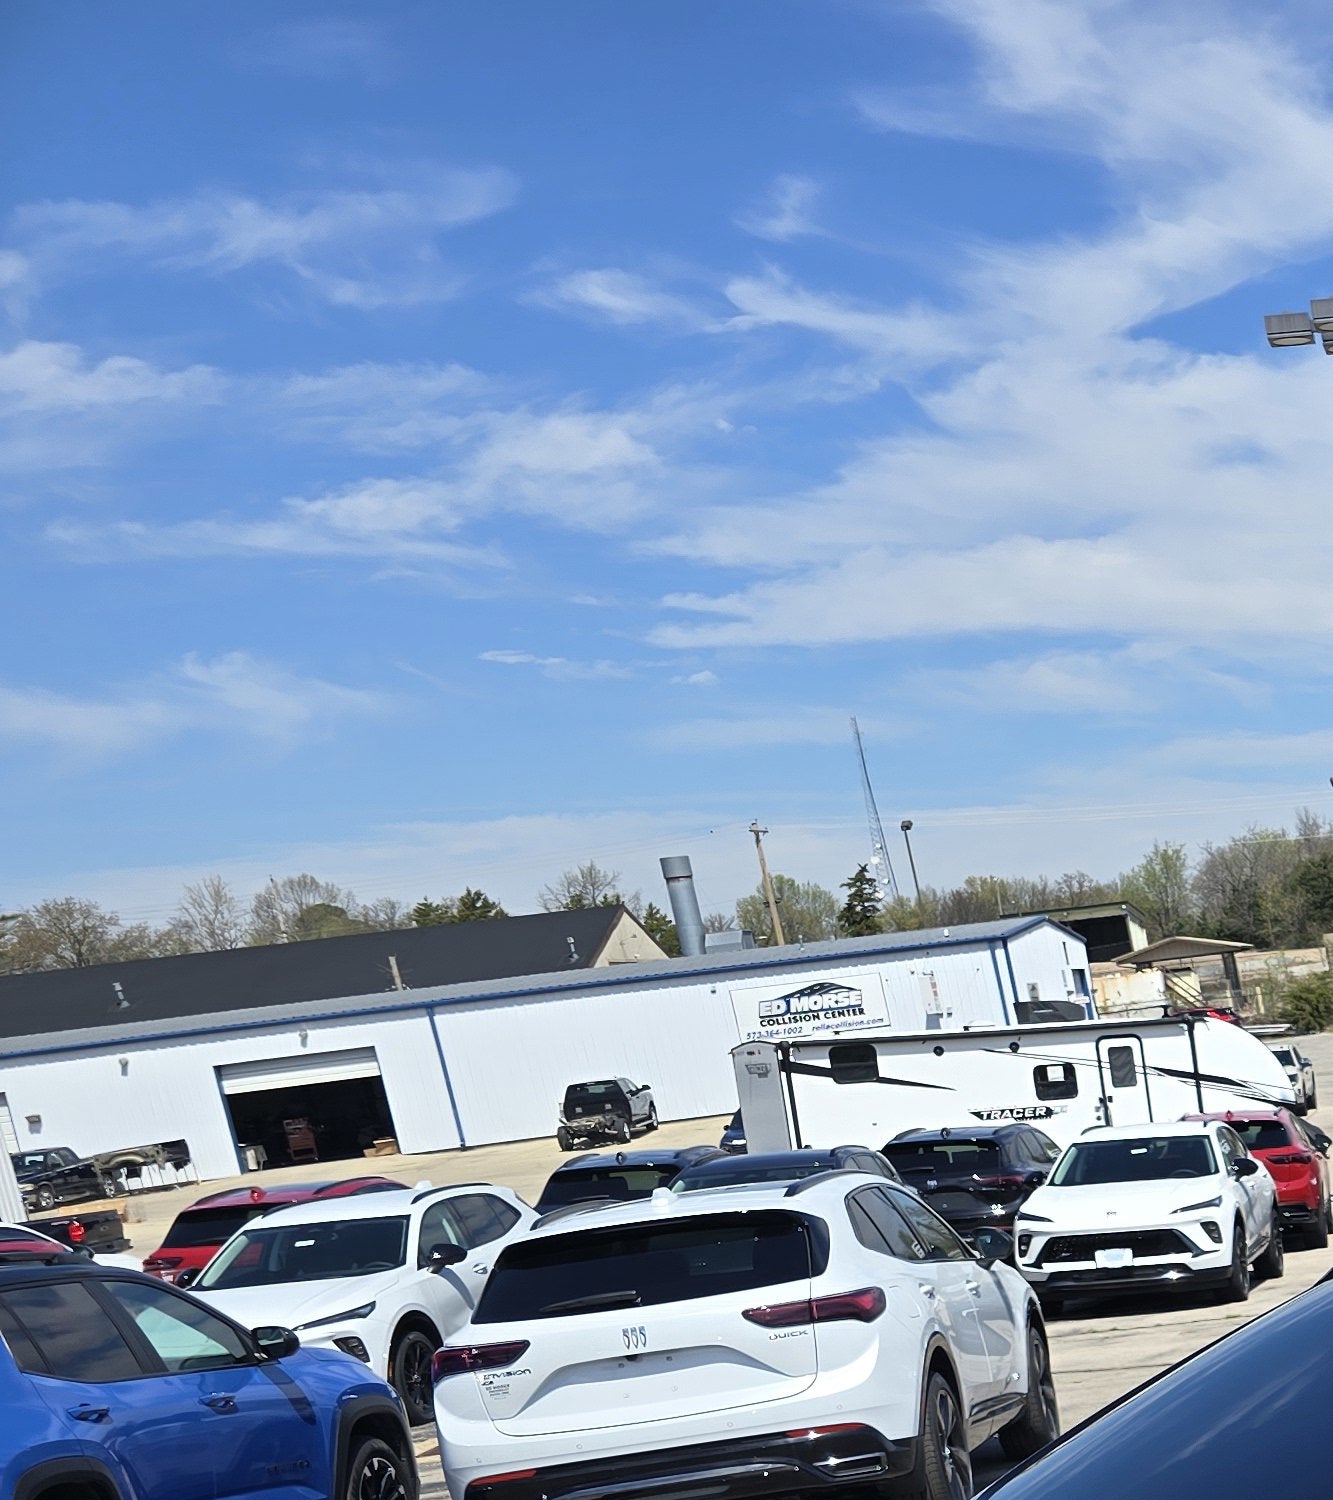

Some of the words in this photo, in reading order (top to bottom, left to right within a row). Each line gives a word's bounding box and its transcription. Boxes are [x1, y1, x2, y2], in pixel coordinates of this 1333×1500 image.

[759, 1000, 786, 1018] ED
[790, 990, 863, 1015] MORSE
[760, 1013, 821, 1027] COLLISION
[823, 1007, 866, 1019] CENTER
[746, 1026, 803, 1039] 573-364-1002
[980, 1106, 1047, 1120] TRACER
